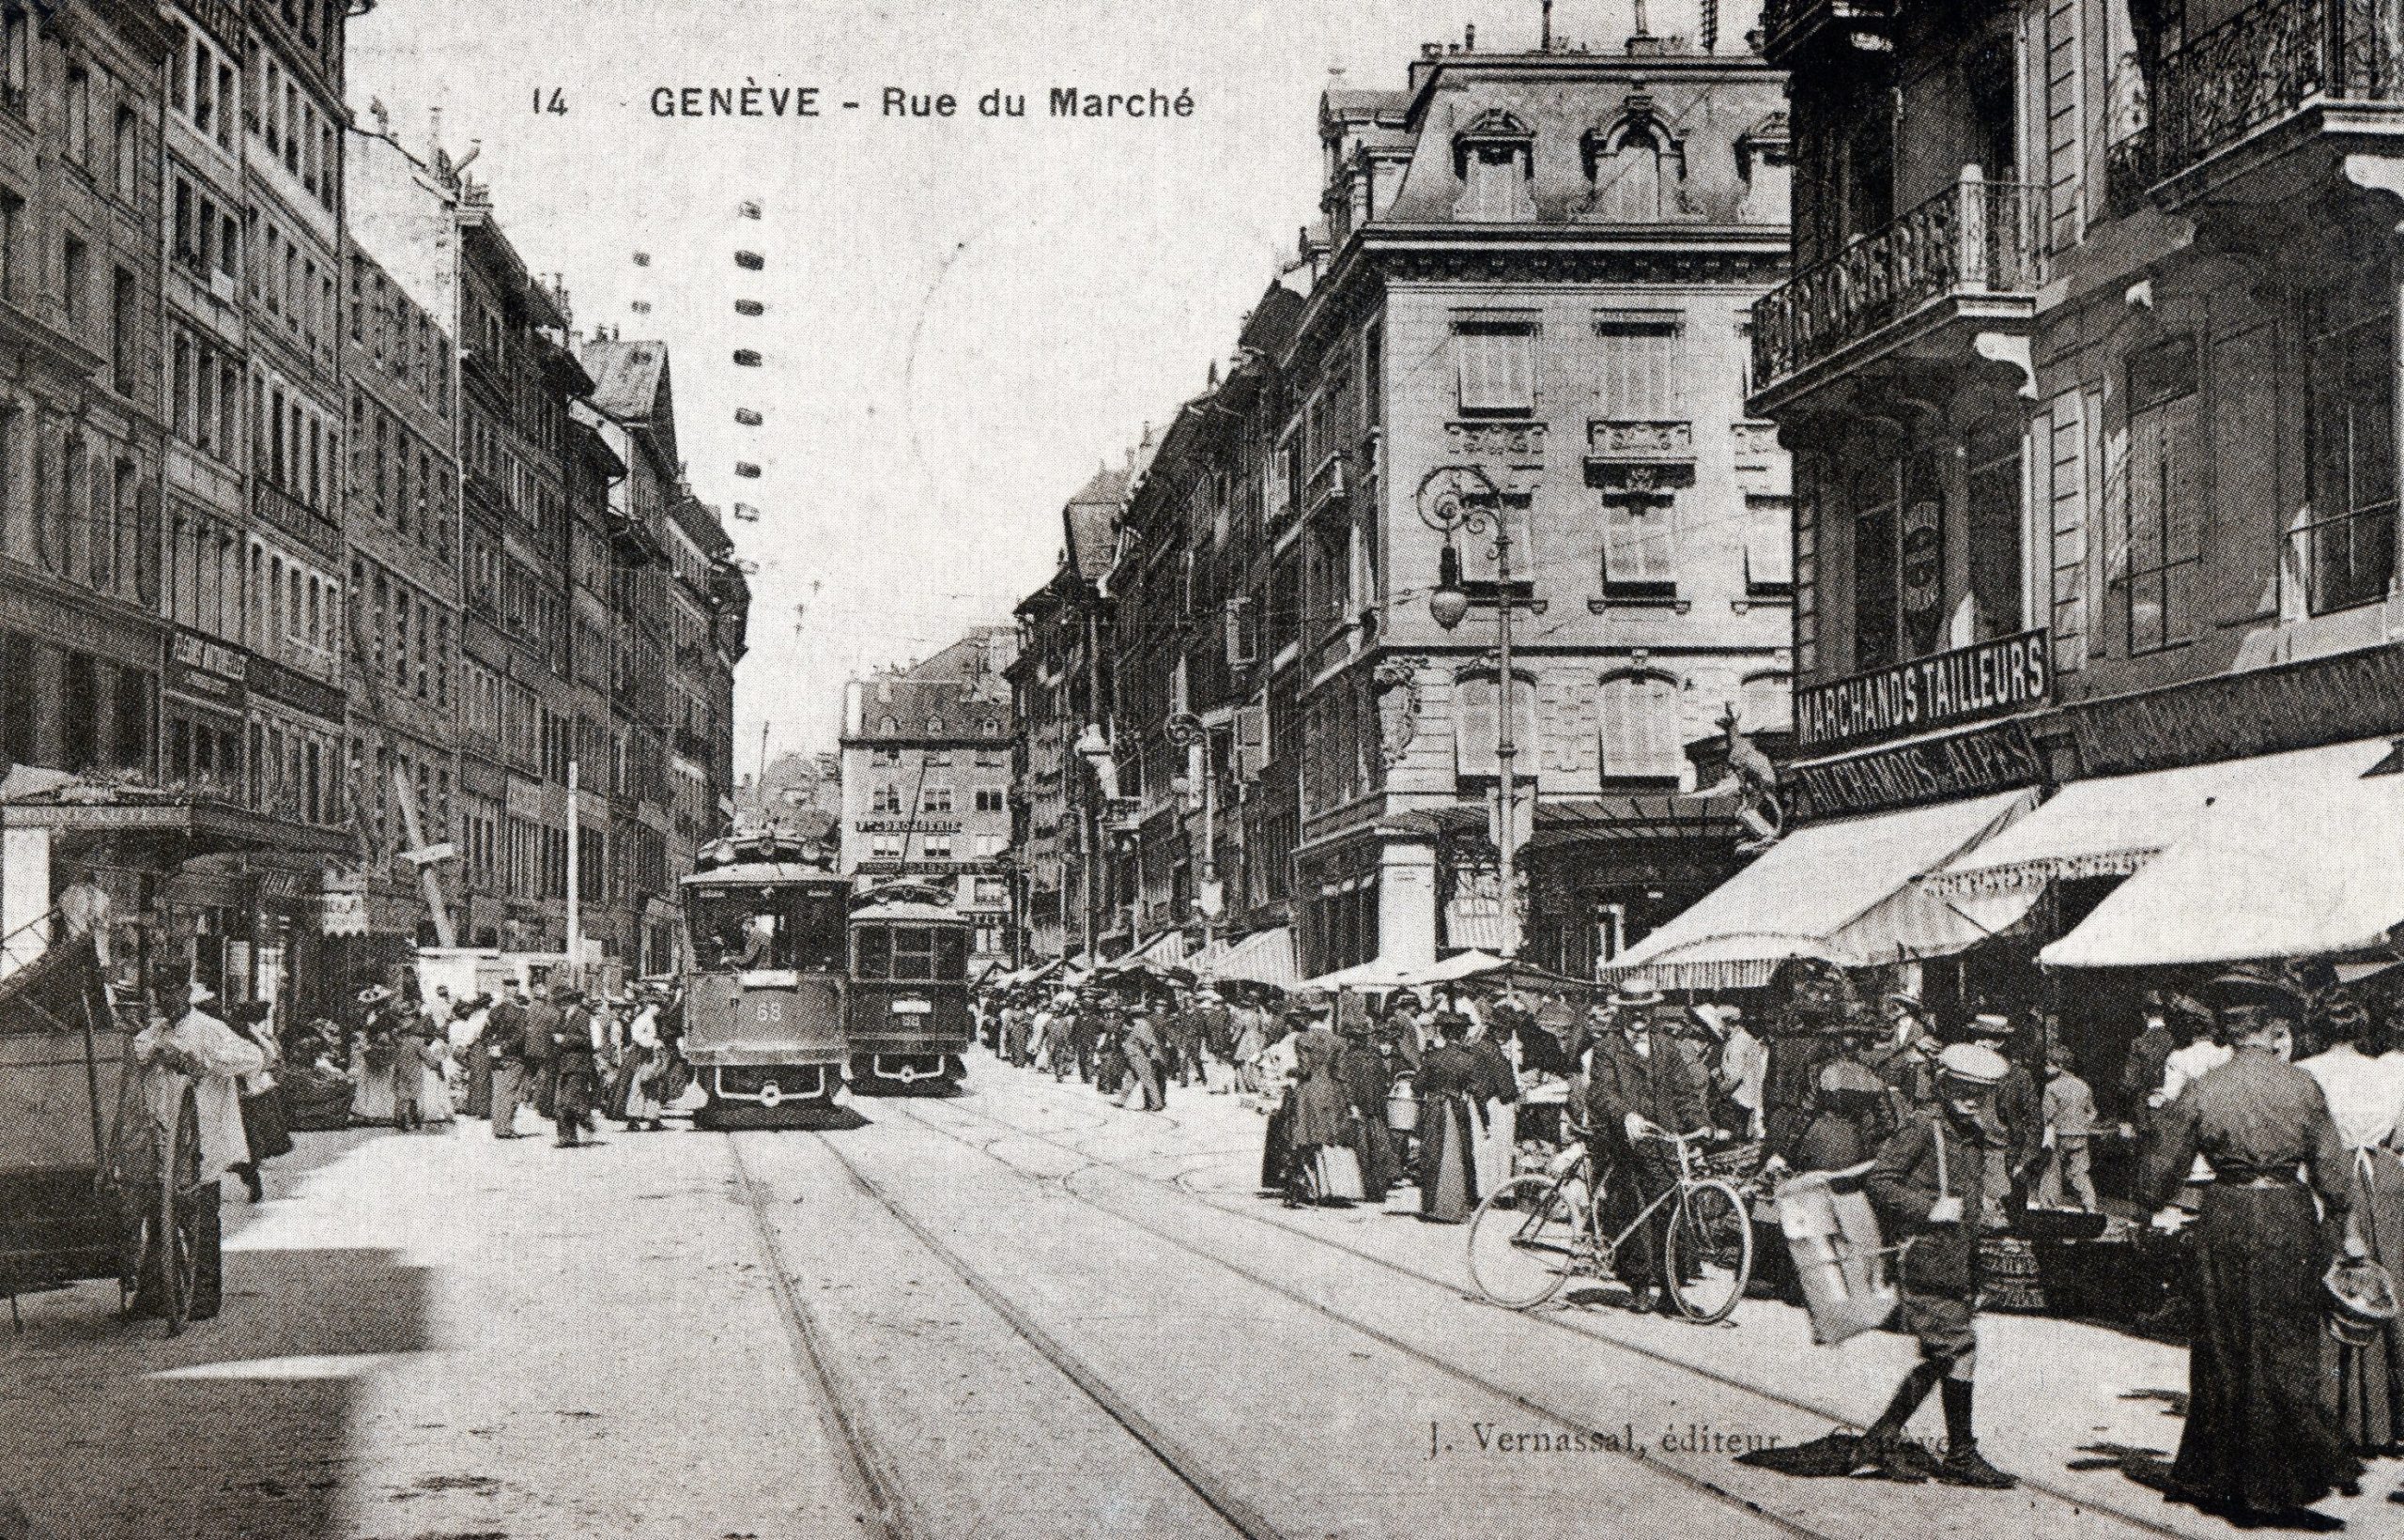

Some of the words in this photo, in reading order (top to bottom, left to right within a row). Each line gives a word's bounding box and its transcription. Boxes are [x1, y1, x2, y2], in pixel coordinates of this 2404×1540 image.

[1797, 667, 1919, 746] MARCHANDS
[1922, 636, 2044, 718] TAILLEURS
[1800, 766, 1841, 813] AU
[1832, 748, 1938, 808] CHAMOIS
